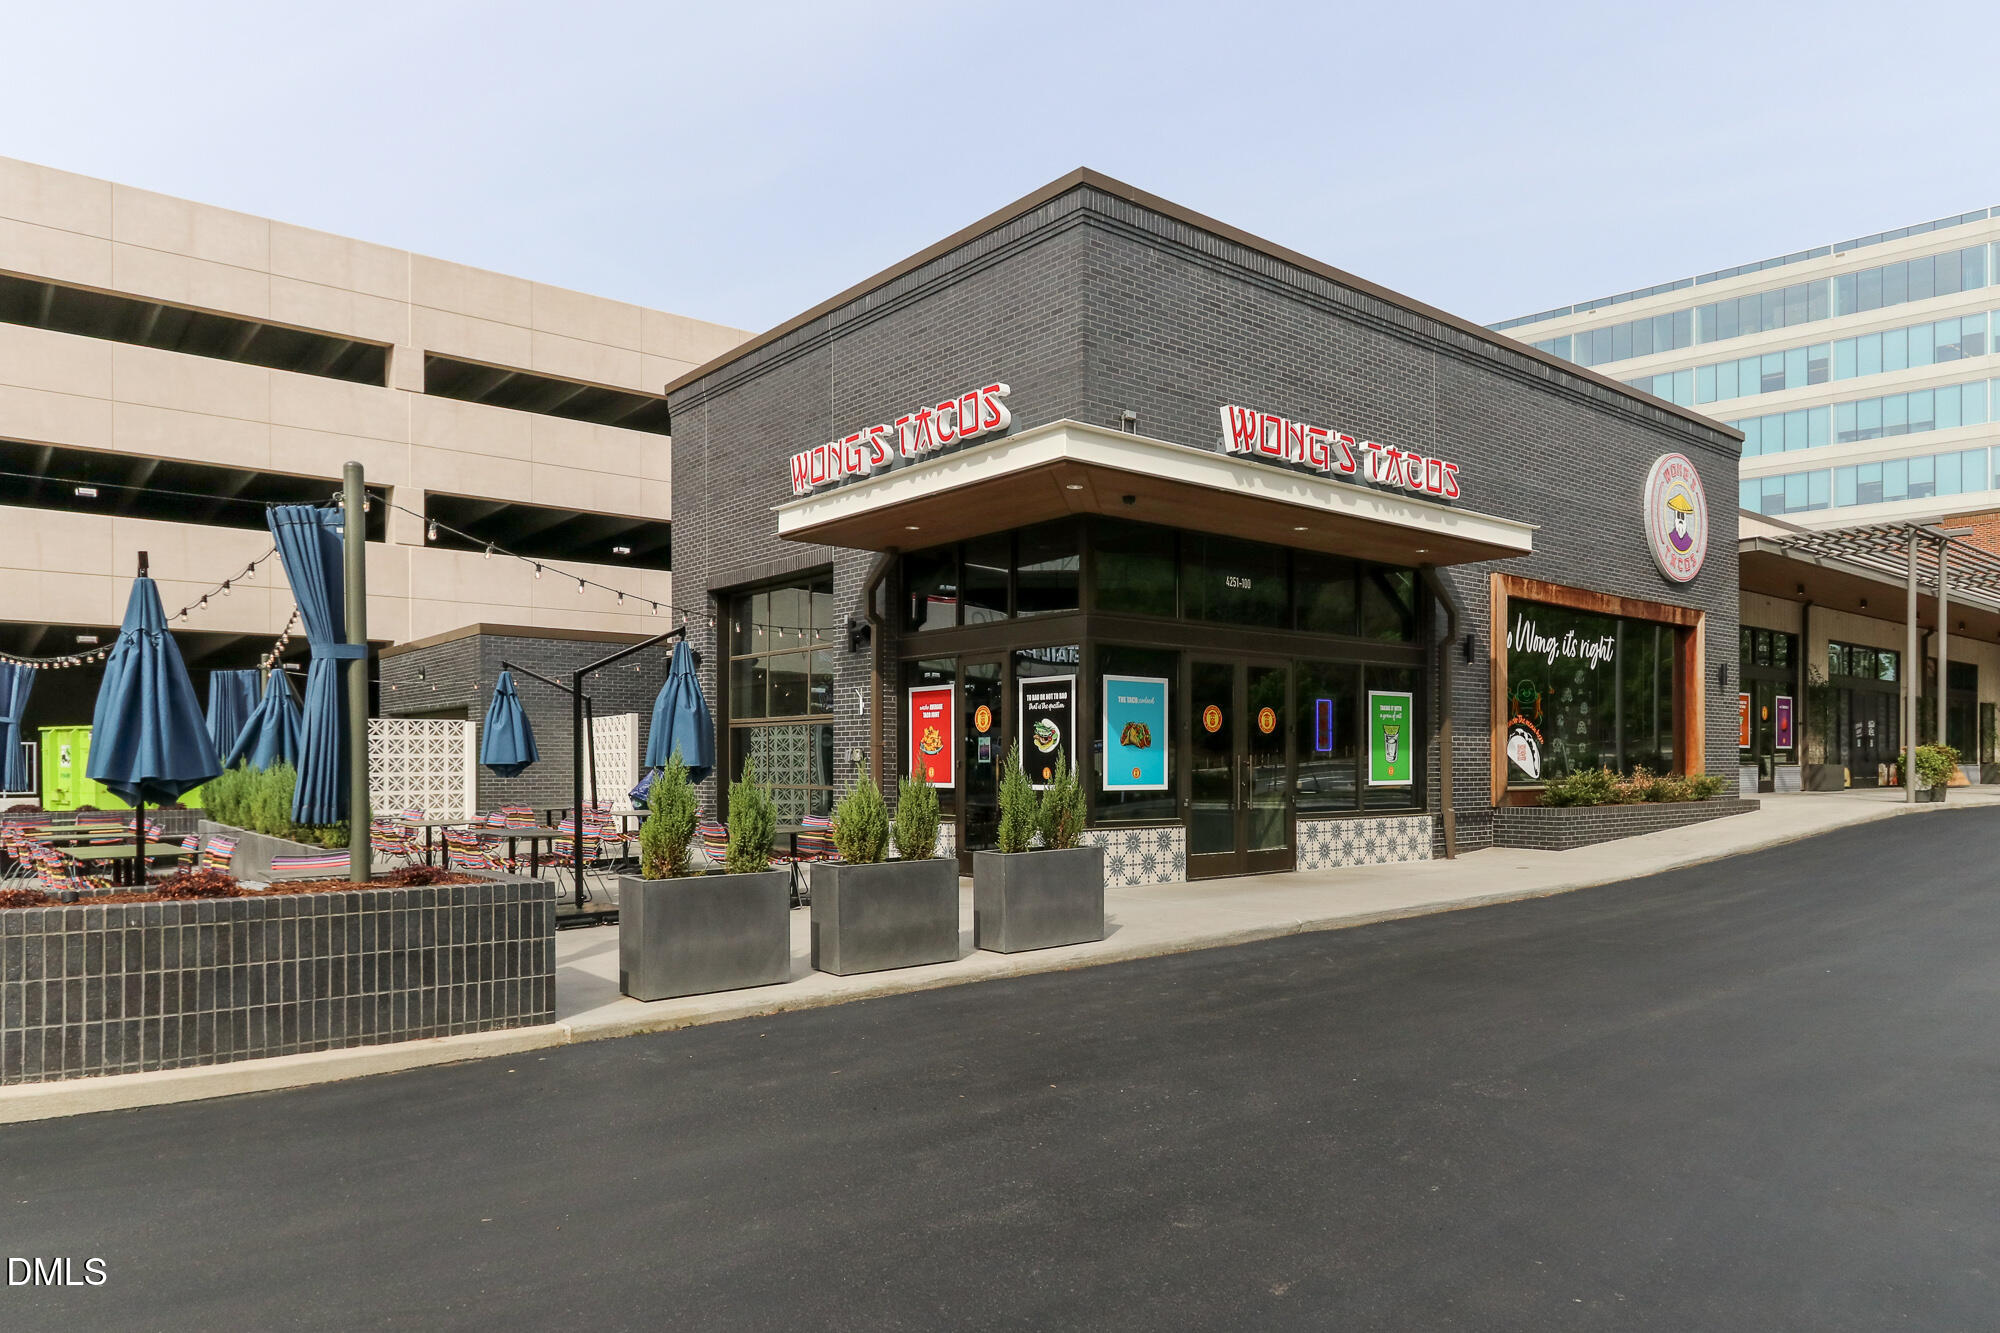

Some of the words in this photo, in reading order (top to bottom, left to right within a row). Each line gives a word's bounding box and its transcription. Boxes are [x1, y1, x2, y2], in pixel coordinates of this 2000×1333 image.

[790, 424, 893, 495] WONG'S
[895, 383, 1011, 458] TACOS
[1220, 404, 1356, 475] WONG'S
[1359, 439, 1460, 500] TACOS
[1663, 463, 1697, 492] WONG'S
[1665, 545, 1697, 572] TACOS
[1226, 575, 1251, 589] 4251-100
[1515, 612, 1560, 666] Wong,
[1580, 635, 1615, 671] right
